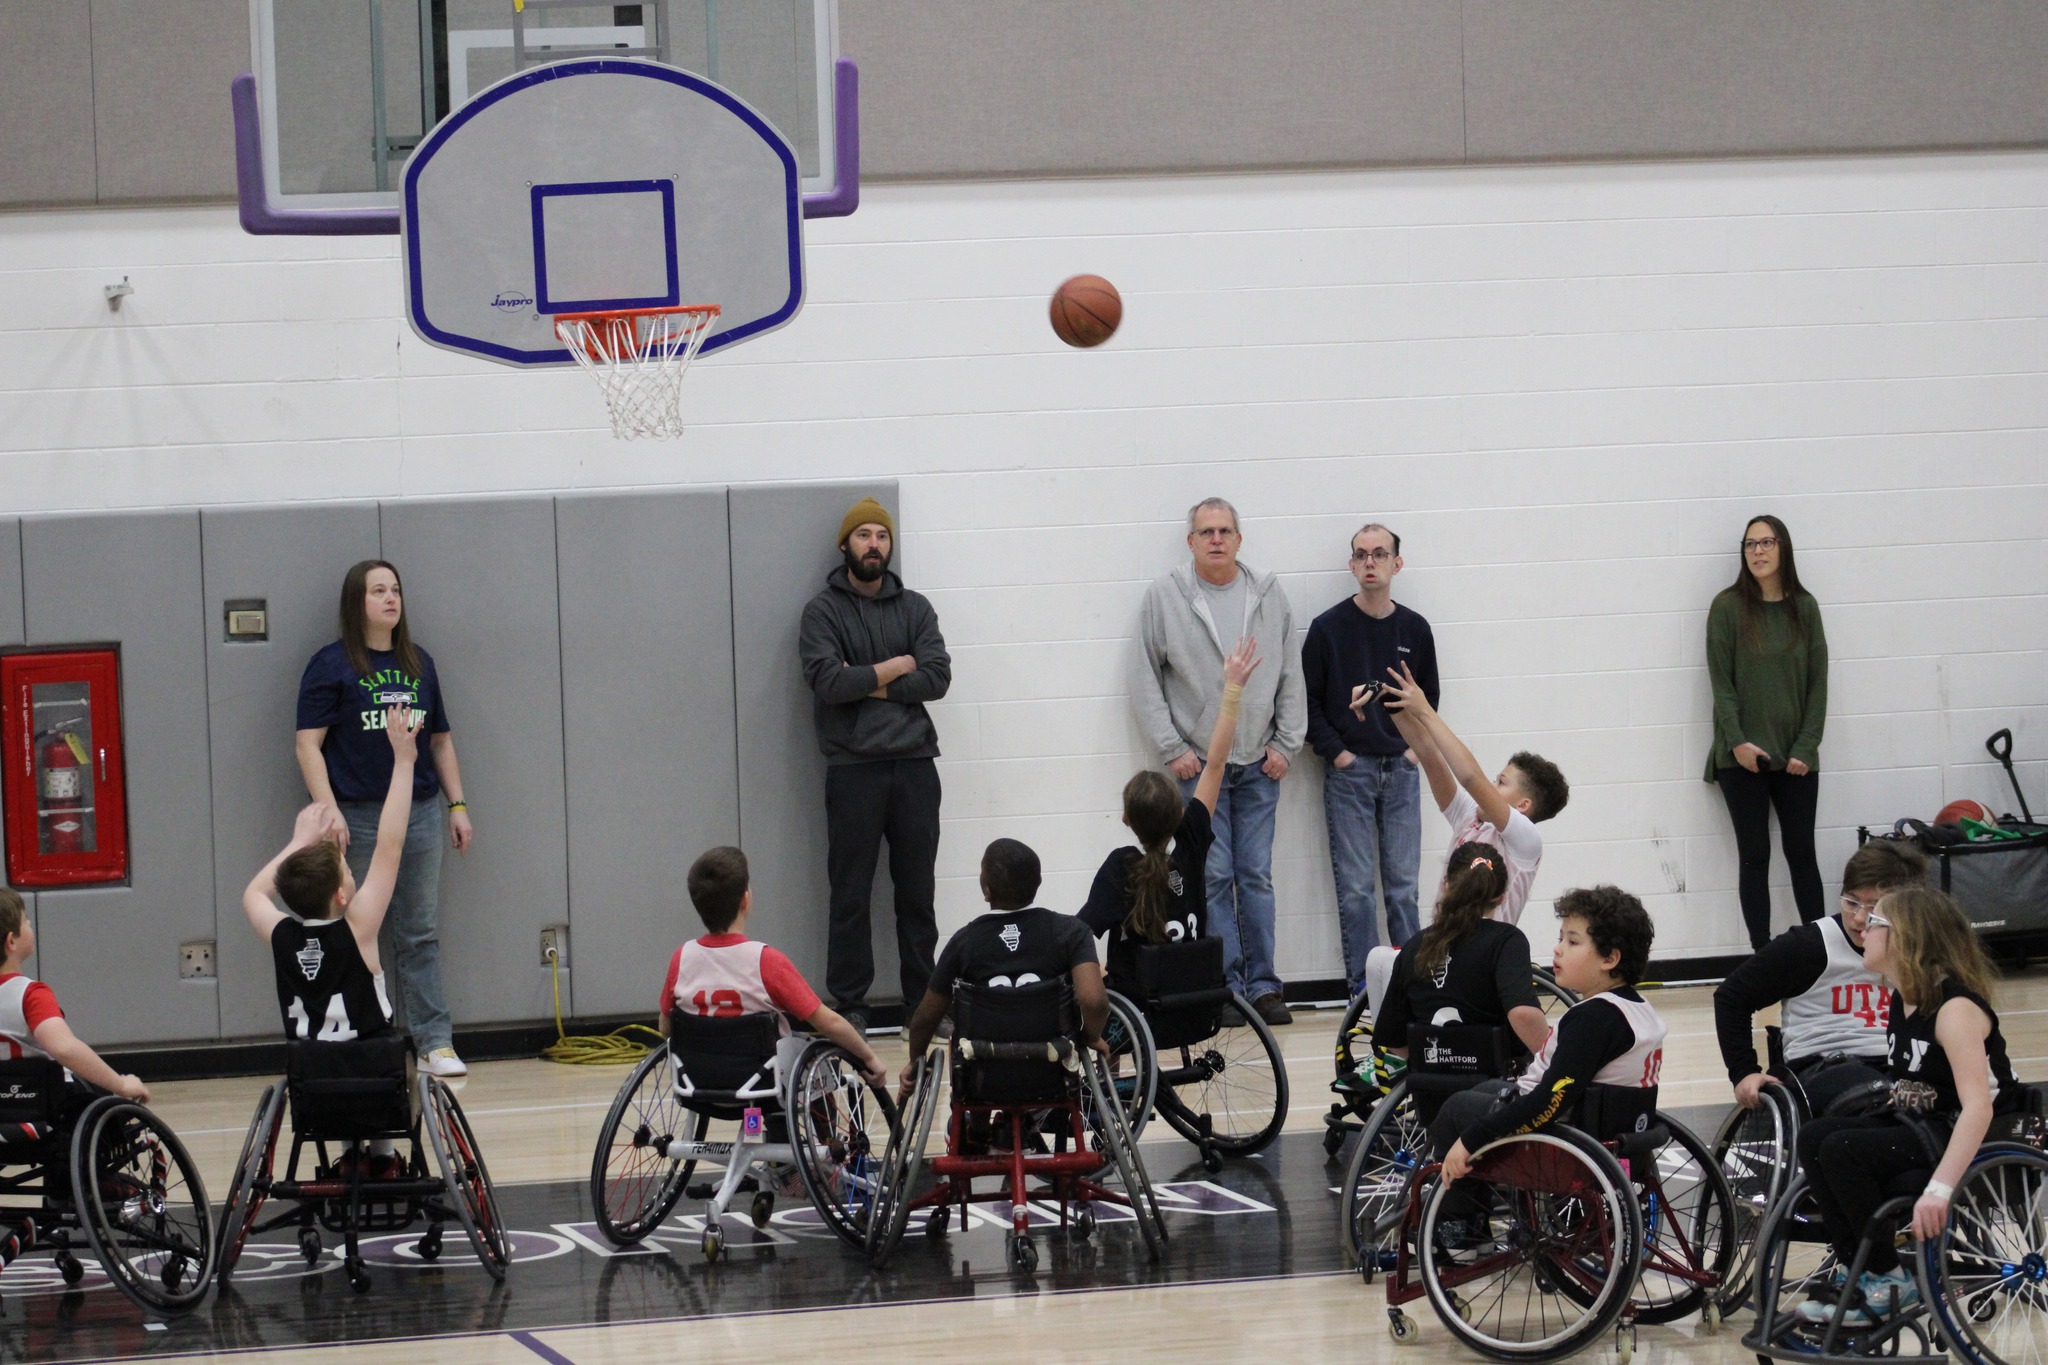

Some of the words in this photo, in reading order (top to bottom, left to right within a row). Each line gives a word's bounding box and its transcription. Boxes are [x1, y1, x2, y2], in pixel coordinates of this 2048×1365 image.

[490, 294, 534, 307] Jaypro
[359, 669, 421, 692] SEATTLE
[1831, 984, 1892, 1014] UTA
[288, 992, 359, 1042] 14
[1438, 1056, 1478, 1064] HARTFORD
[1439, 1048, 1452, 1056] THE
